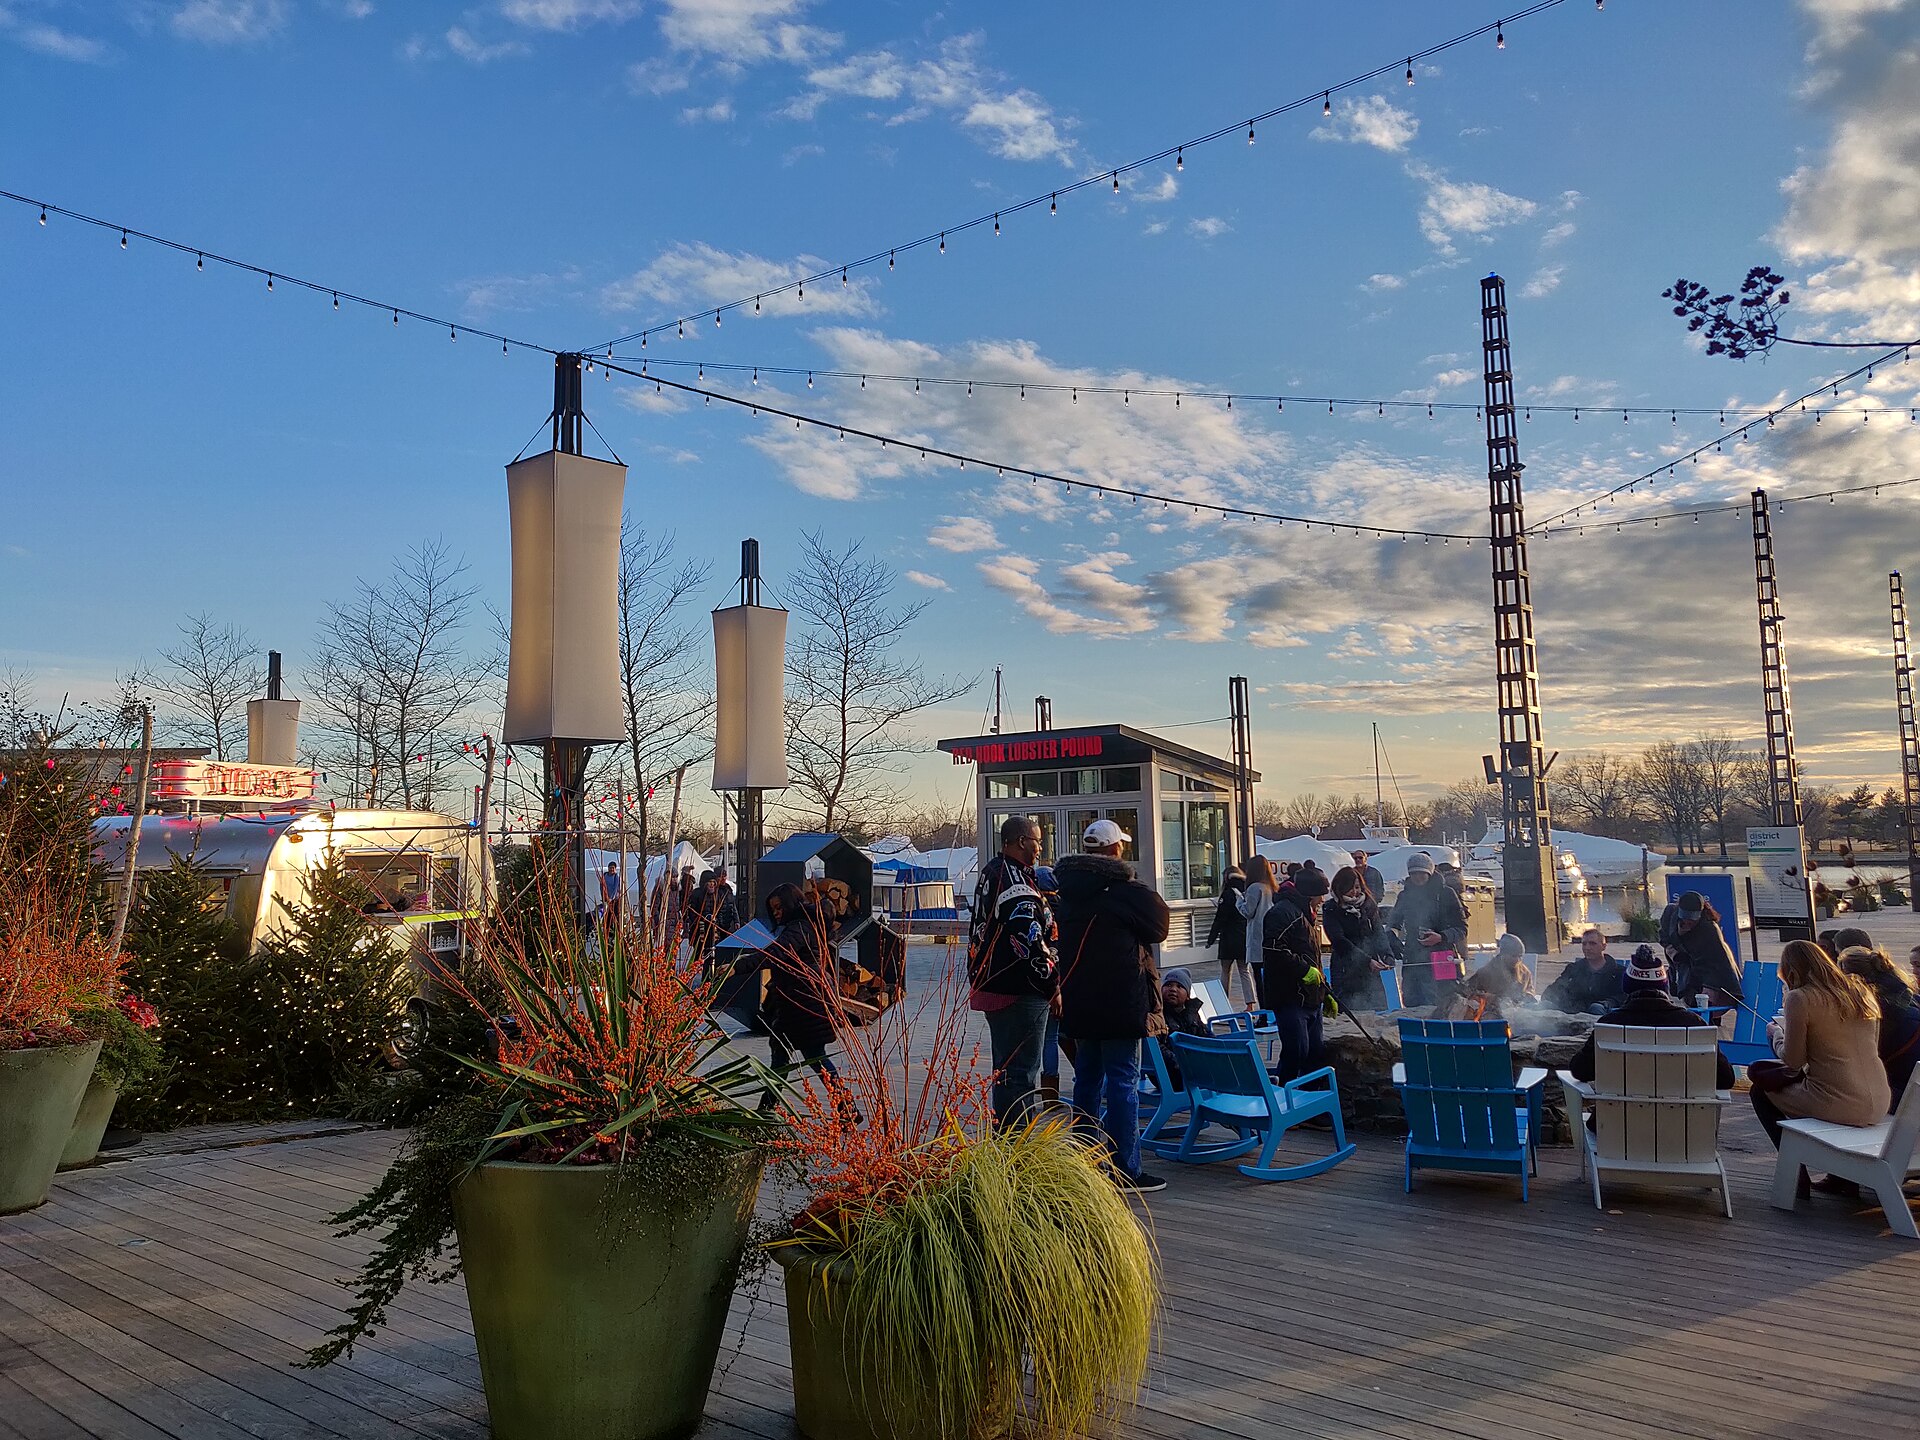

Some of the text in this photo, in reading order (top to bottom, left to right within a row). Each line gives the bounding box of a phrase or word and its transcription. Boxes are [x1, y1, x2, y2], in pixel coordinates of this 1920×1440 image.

[952, 735, 1103, 765] RED HOOK LOBSTER POUND
[1749, 832, 1780, 840] district
[1749, 840, 1767, 848] pier
